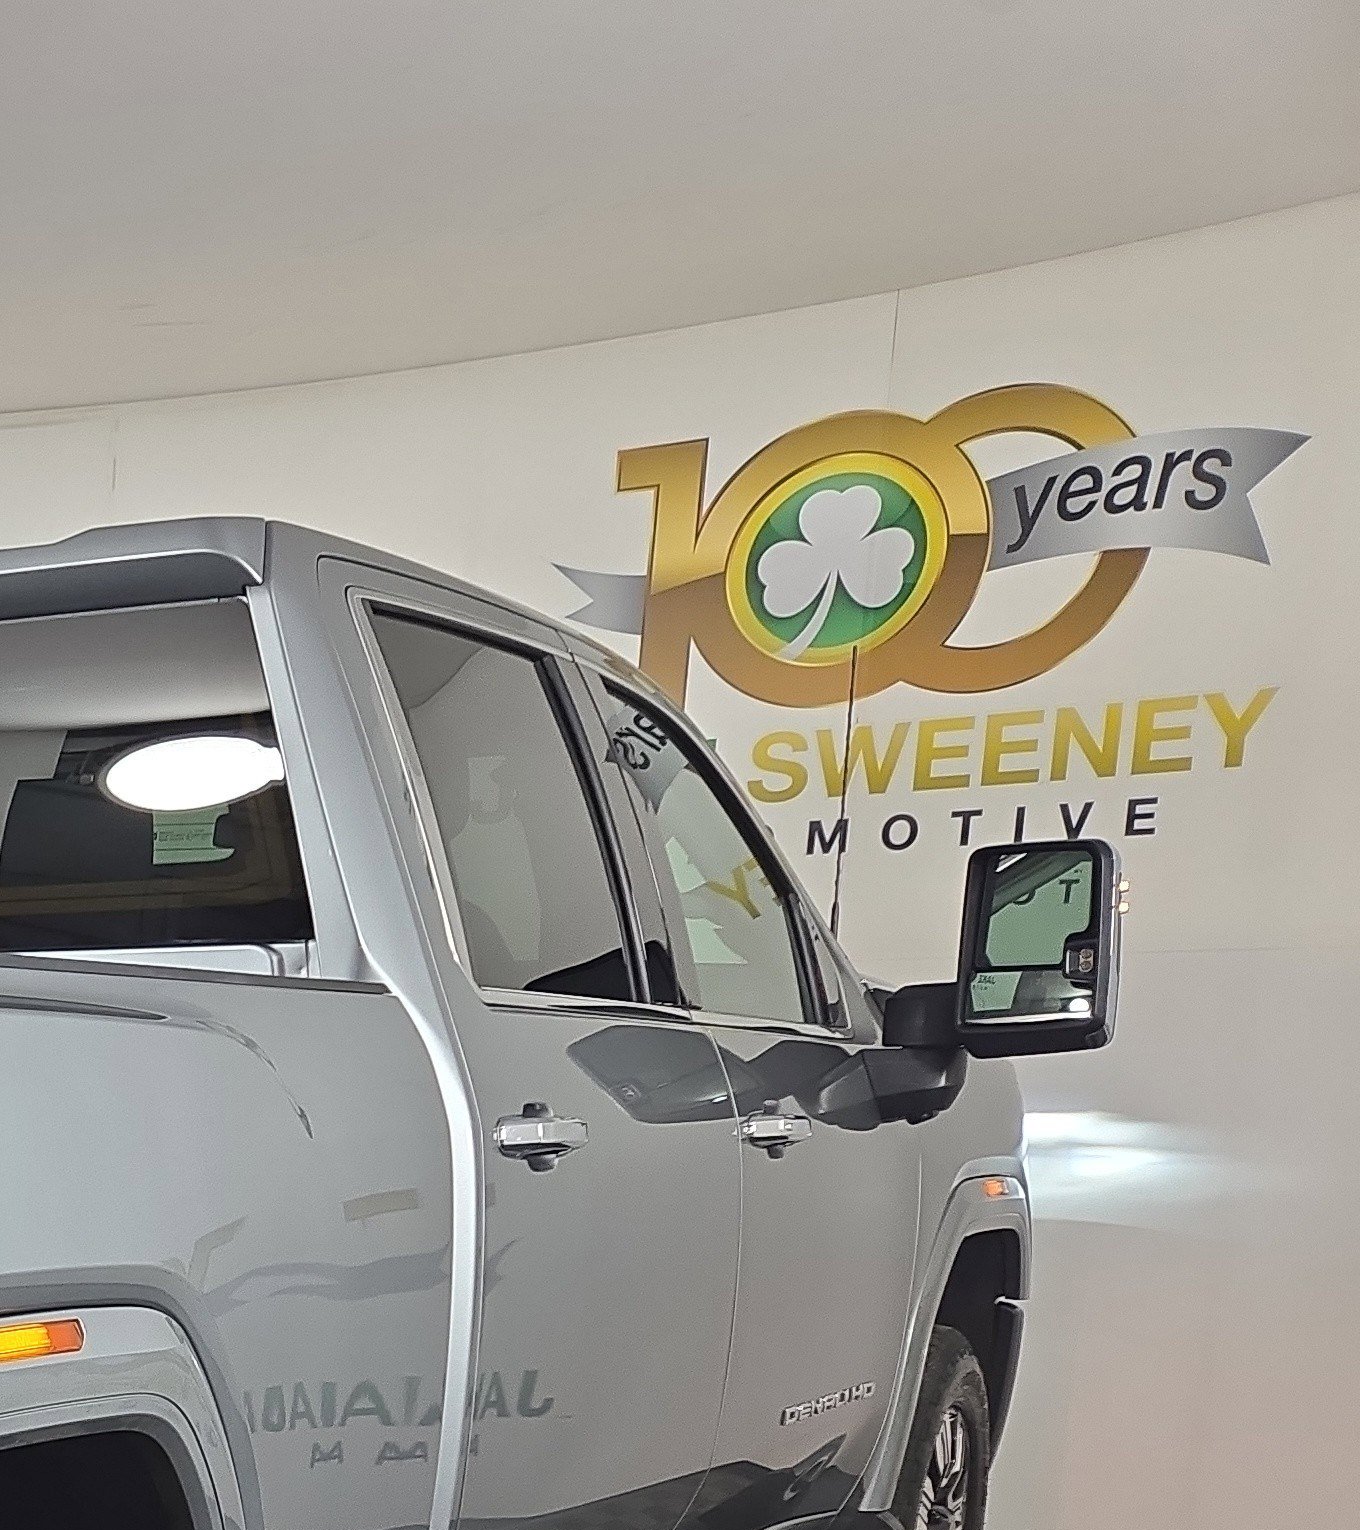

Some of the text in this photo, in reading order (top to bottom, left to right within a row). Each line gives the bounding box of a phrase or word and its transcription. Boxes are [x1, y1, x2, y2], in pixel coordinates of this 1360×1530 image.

[616, 382, 1152, 715] 100
[1007, 446, 1235, 553] years
[747, 686, 1280, 804] SWEENEY
[805, 796, 1160, 856] MOTIVE
